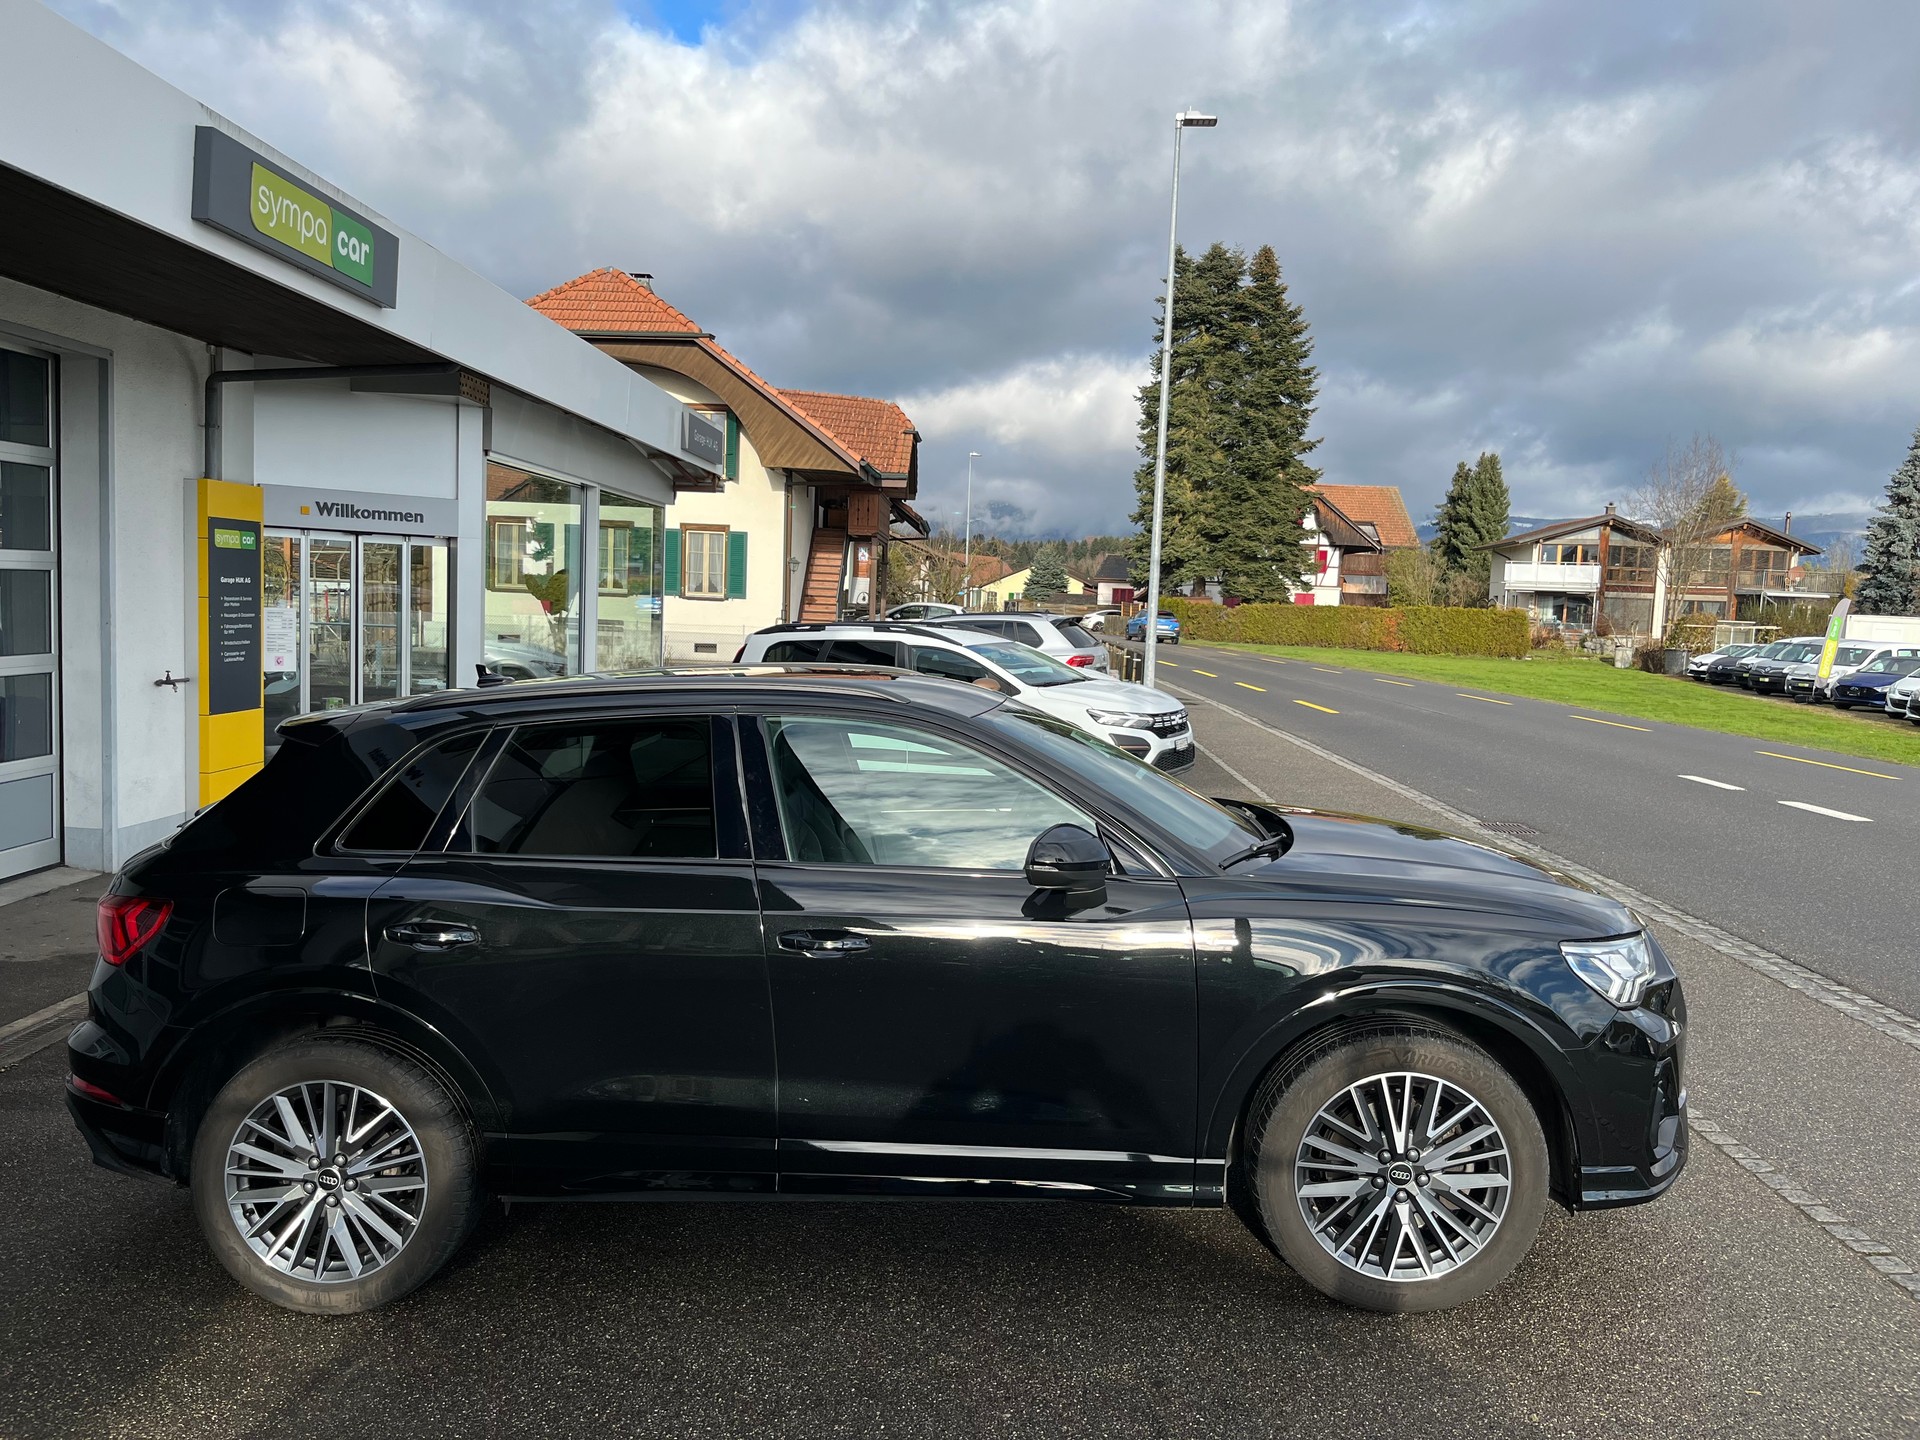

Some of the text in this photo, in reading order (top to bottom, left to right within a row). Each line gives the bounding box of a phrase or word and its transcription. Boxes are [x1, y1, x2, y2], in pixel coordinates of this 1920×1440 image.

[258, 185, 370, 266] sympa car
[315, 501, 424, 523] Willkommen
[216, 534, 255, 545] sympa car
[220, 576, 235, 584] Garage
